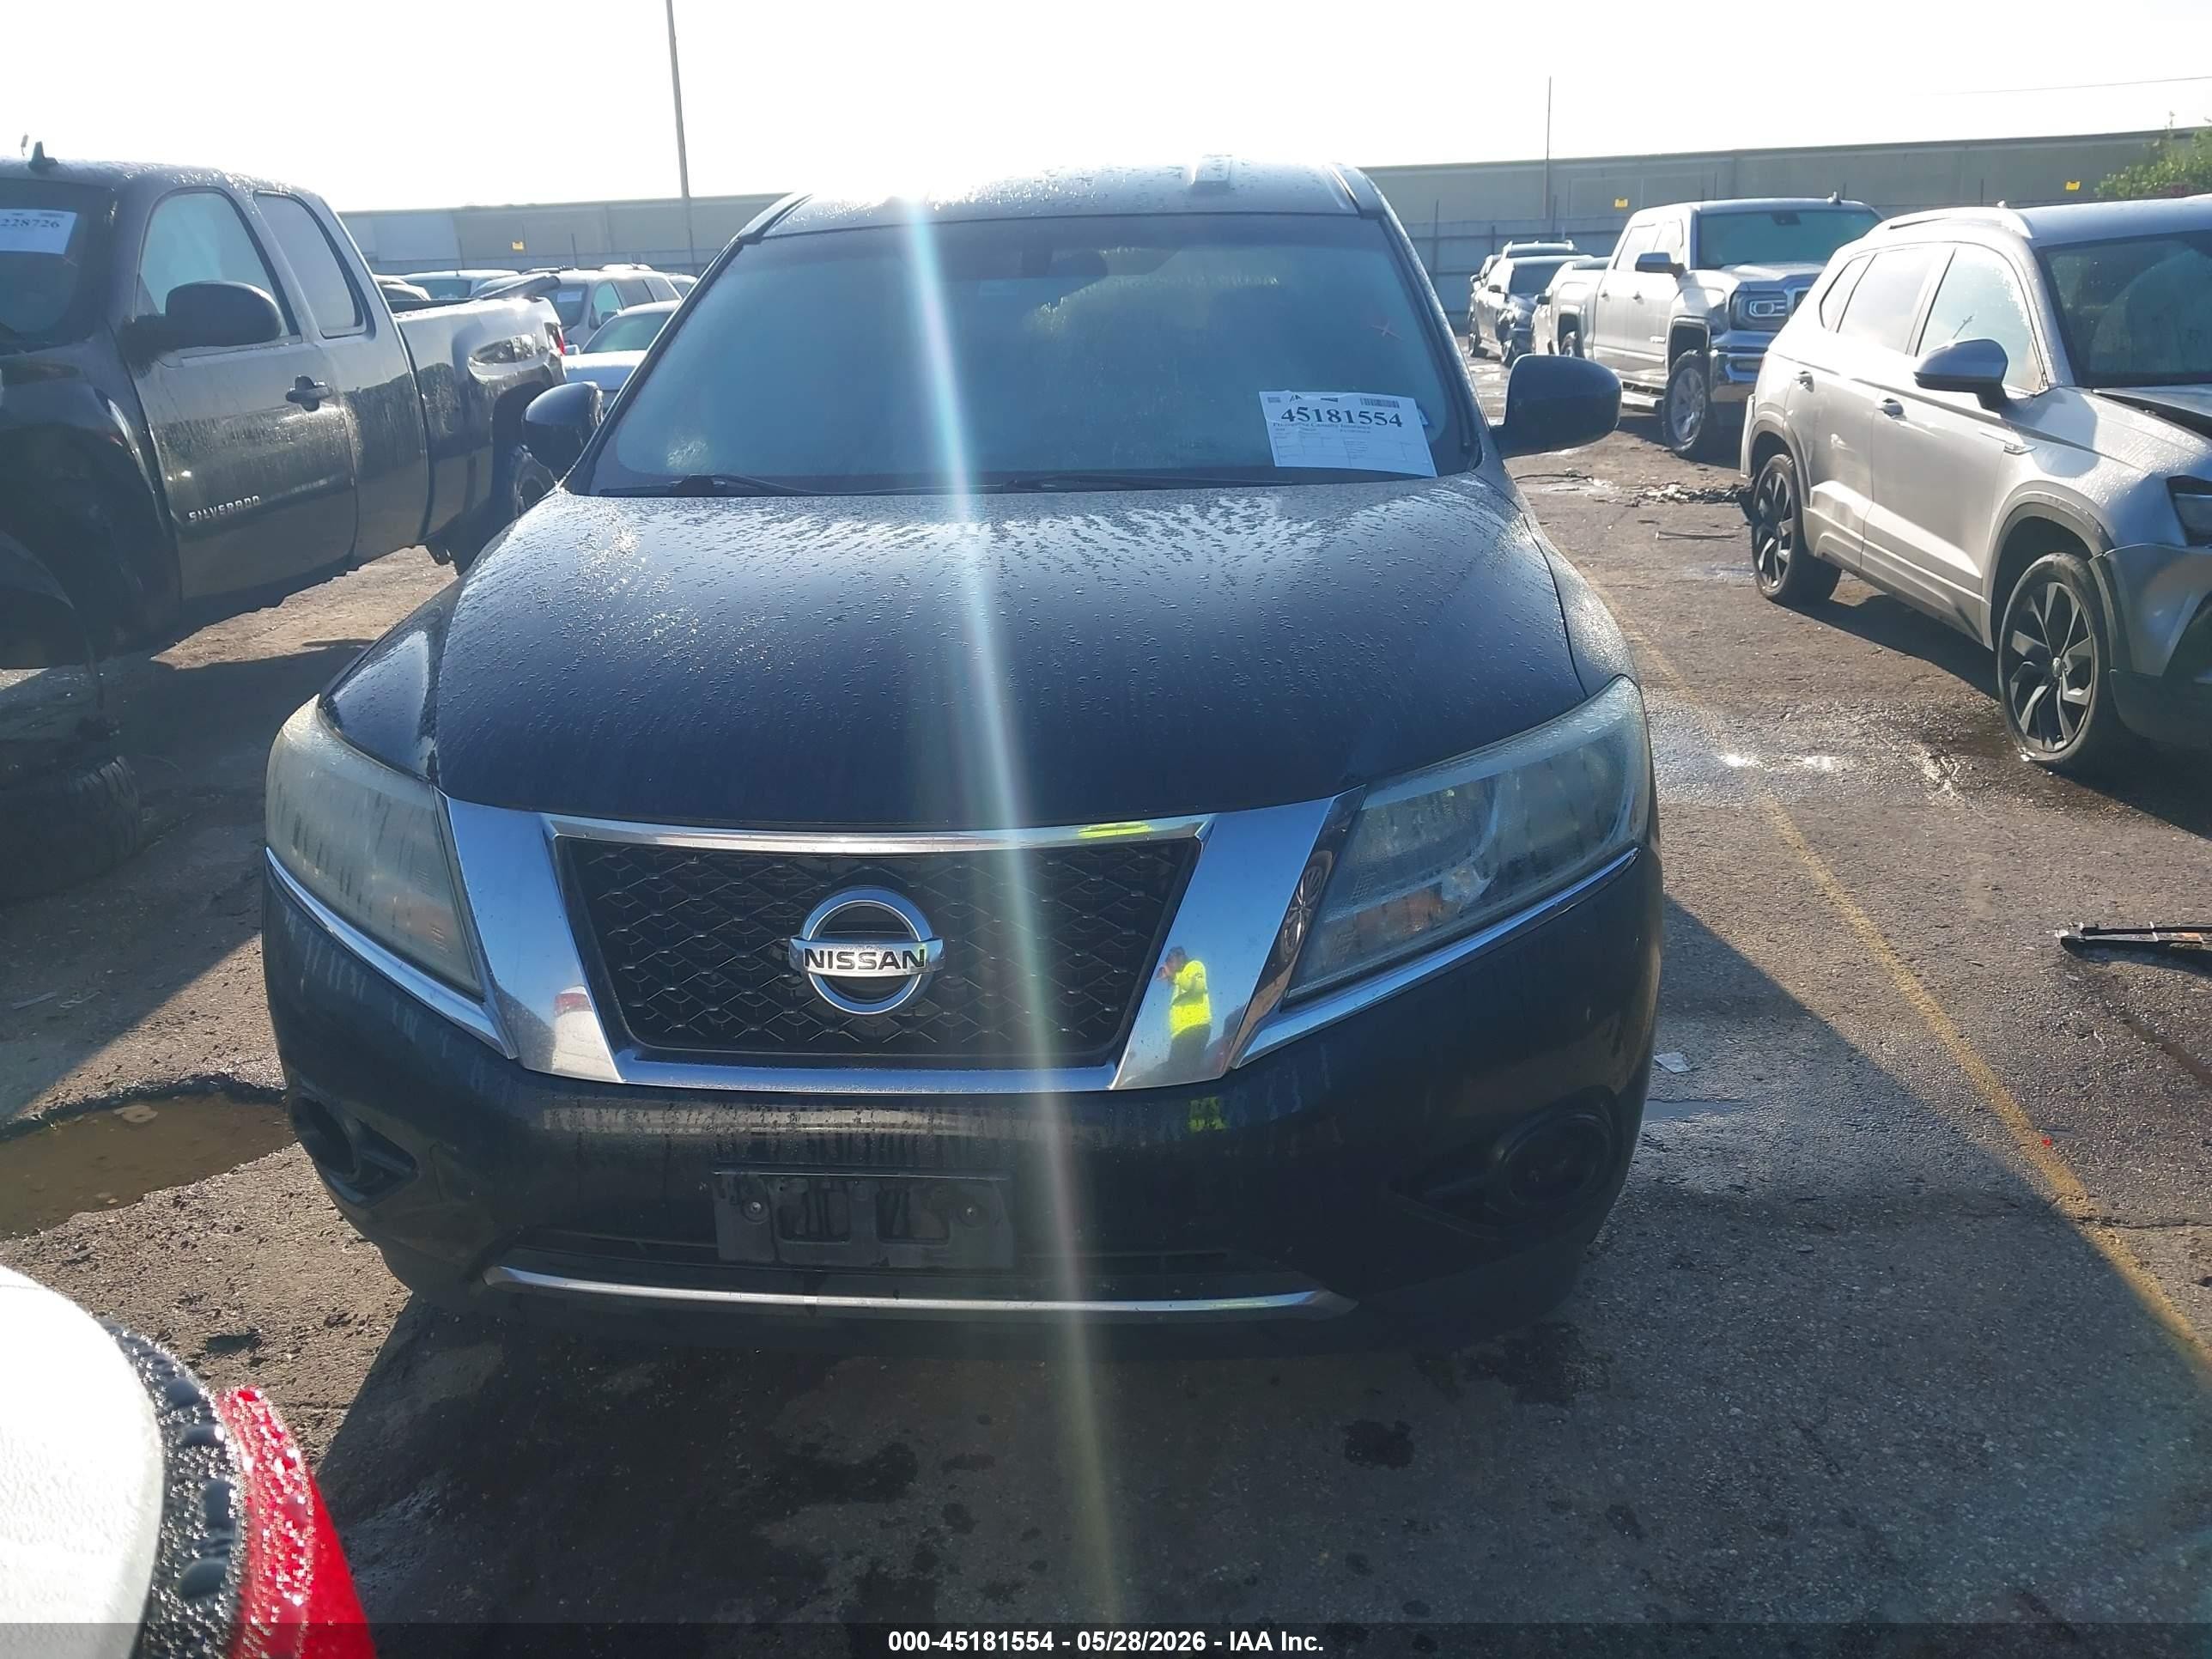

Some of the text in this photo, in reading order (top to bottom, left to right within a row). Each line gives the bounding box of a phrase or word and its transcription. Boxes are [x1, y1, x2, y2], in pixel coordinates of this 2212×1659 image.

[1281, 406, 1403, 428] 45181554
[188, 495, 262, 523] SILVERADO
[804, 948, 927, 970] NISSAN
